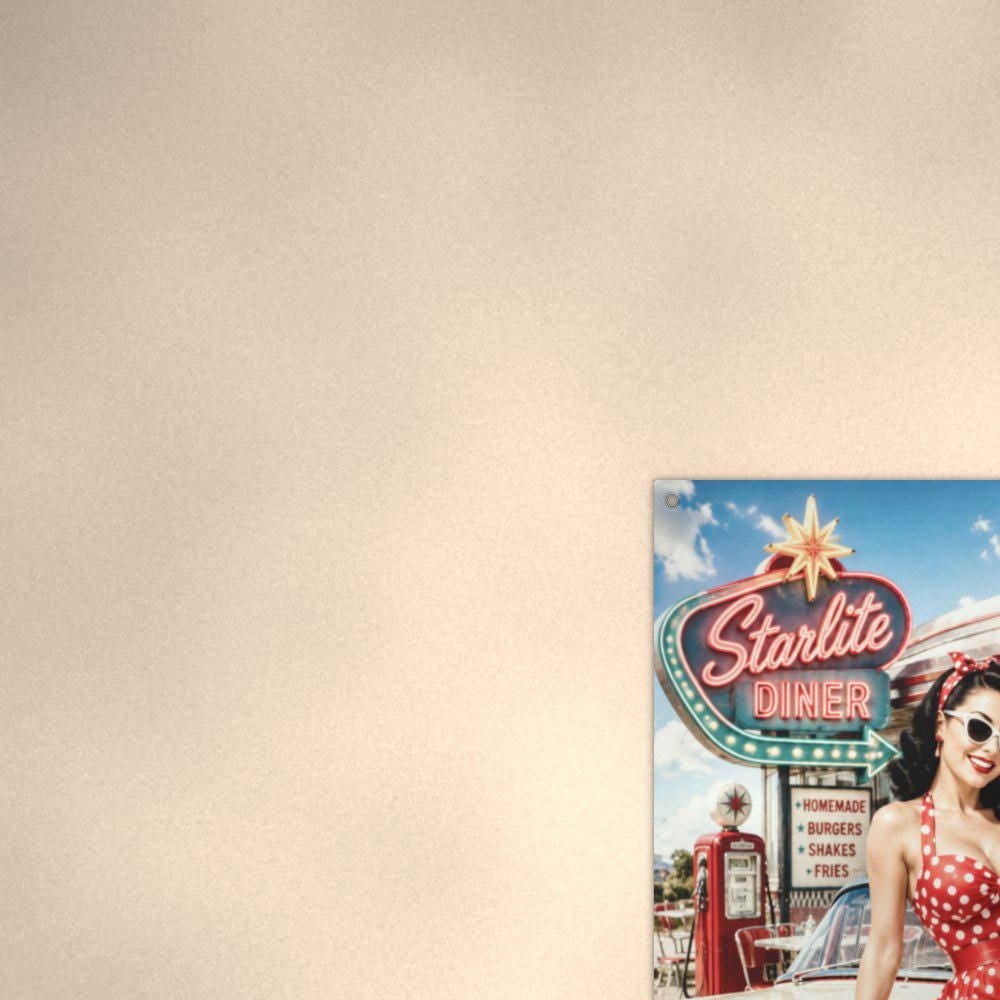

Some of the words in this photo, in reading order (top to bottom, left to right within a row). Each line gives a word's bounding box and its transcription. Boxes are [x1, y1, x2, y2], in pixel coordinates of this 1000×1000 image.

[702, 591, 893, 686] Starlite
[754, 681, 871, 720] DINER
[803, 799, 866, 813] HOMEMADE
[807, 821, 863, 836] BURGERS
[808, 843, 856, 857] SHAKES
[814, 864, 849, 878] FRIES
